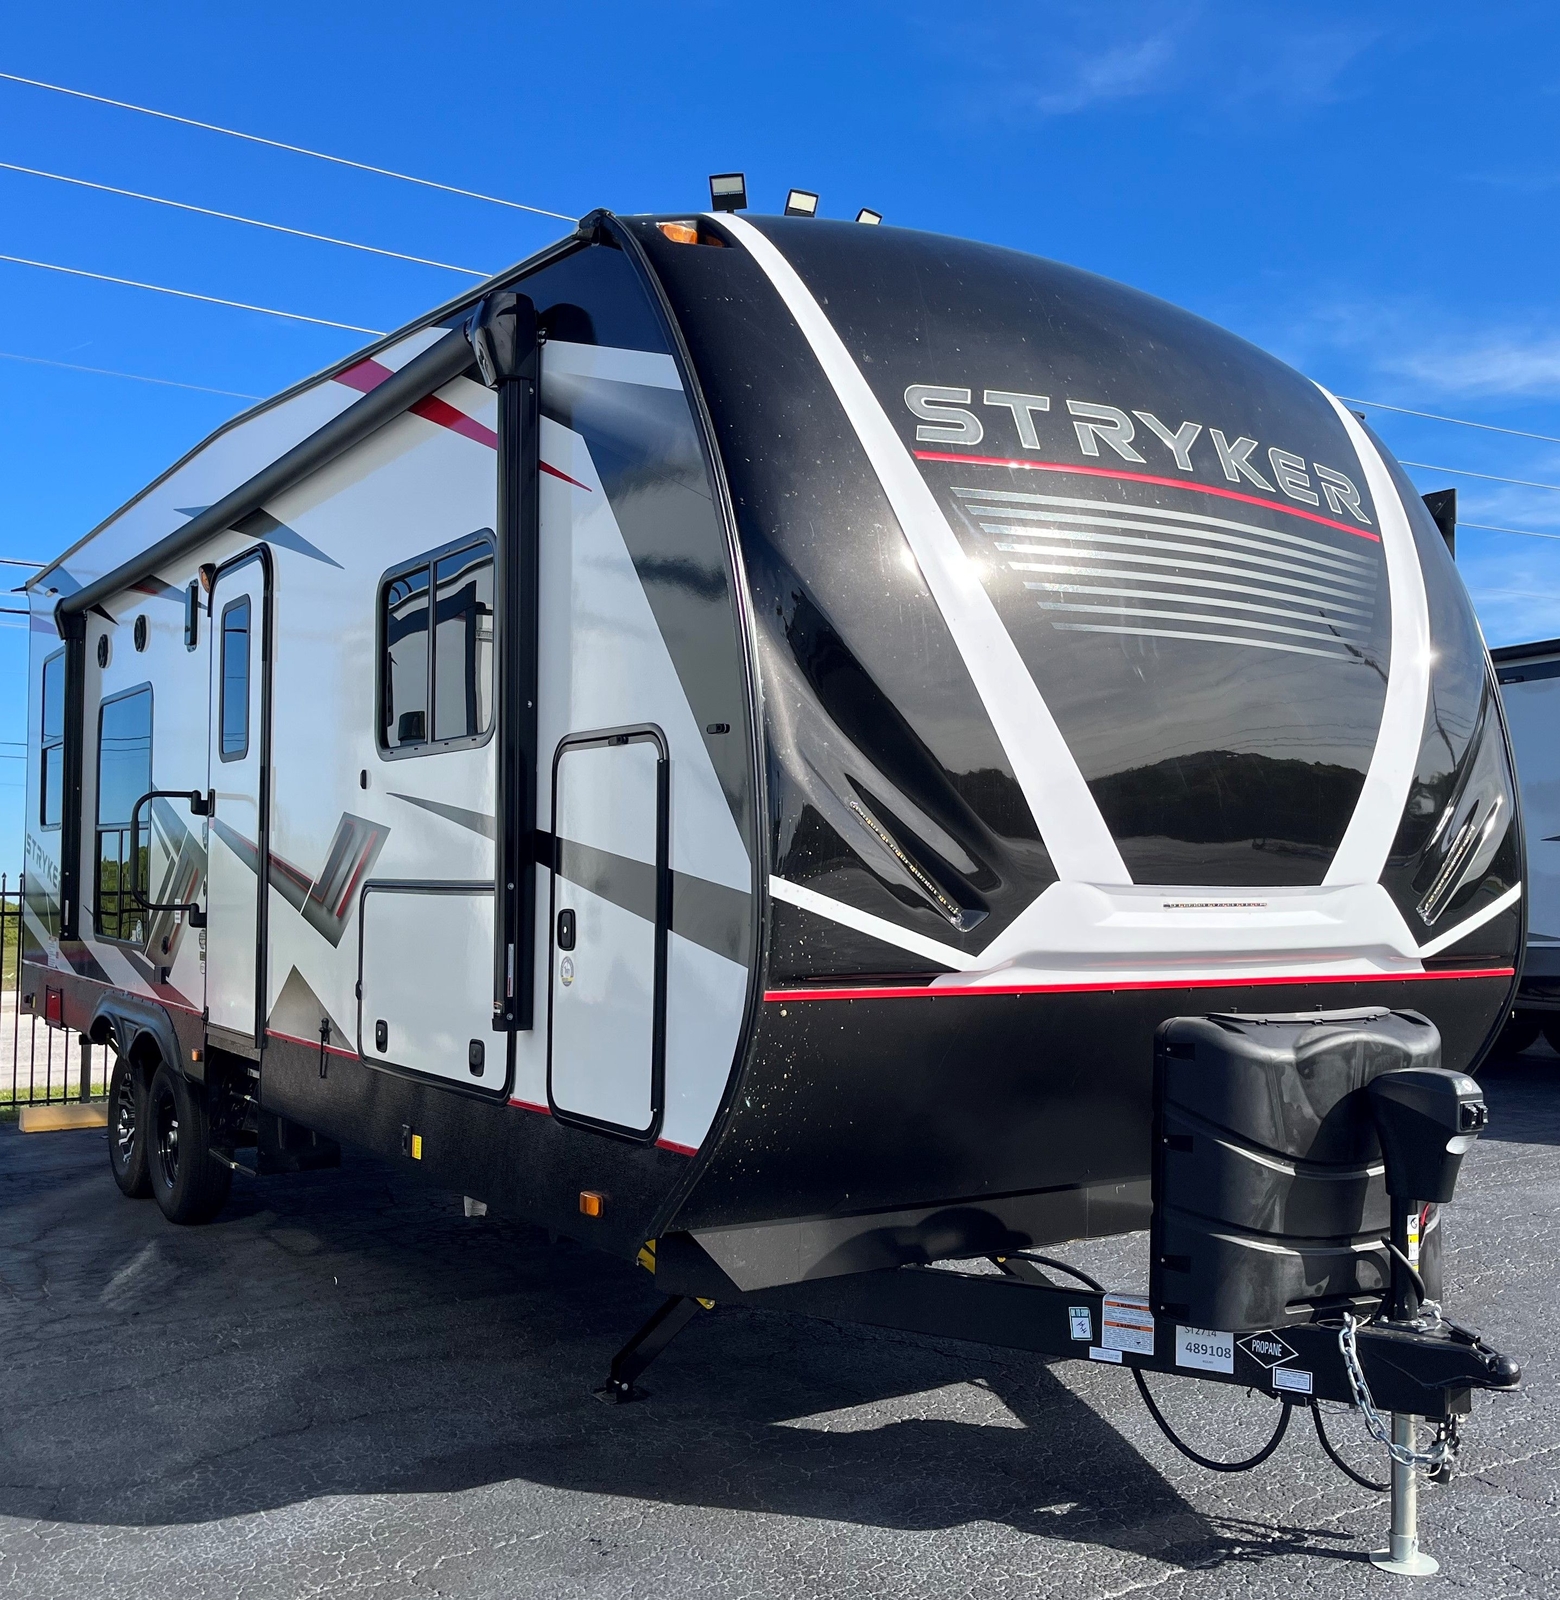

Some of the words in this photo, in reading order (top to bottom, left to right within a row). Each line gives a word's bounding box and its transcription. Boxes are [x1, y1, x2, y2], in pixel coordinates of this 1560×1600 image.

[903, 383, 1373, 526] STRYKER
[26, 832, 60, 890] STRYKE
[1185, 1341, 1232, 1359] 489108
[1251, 1339, 1283, 1357] PROPANE
